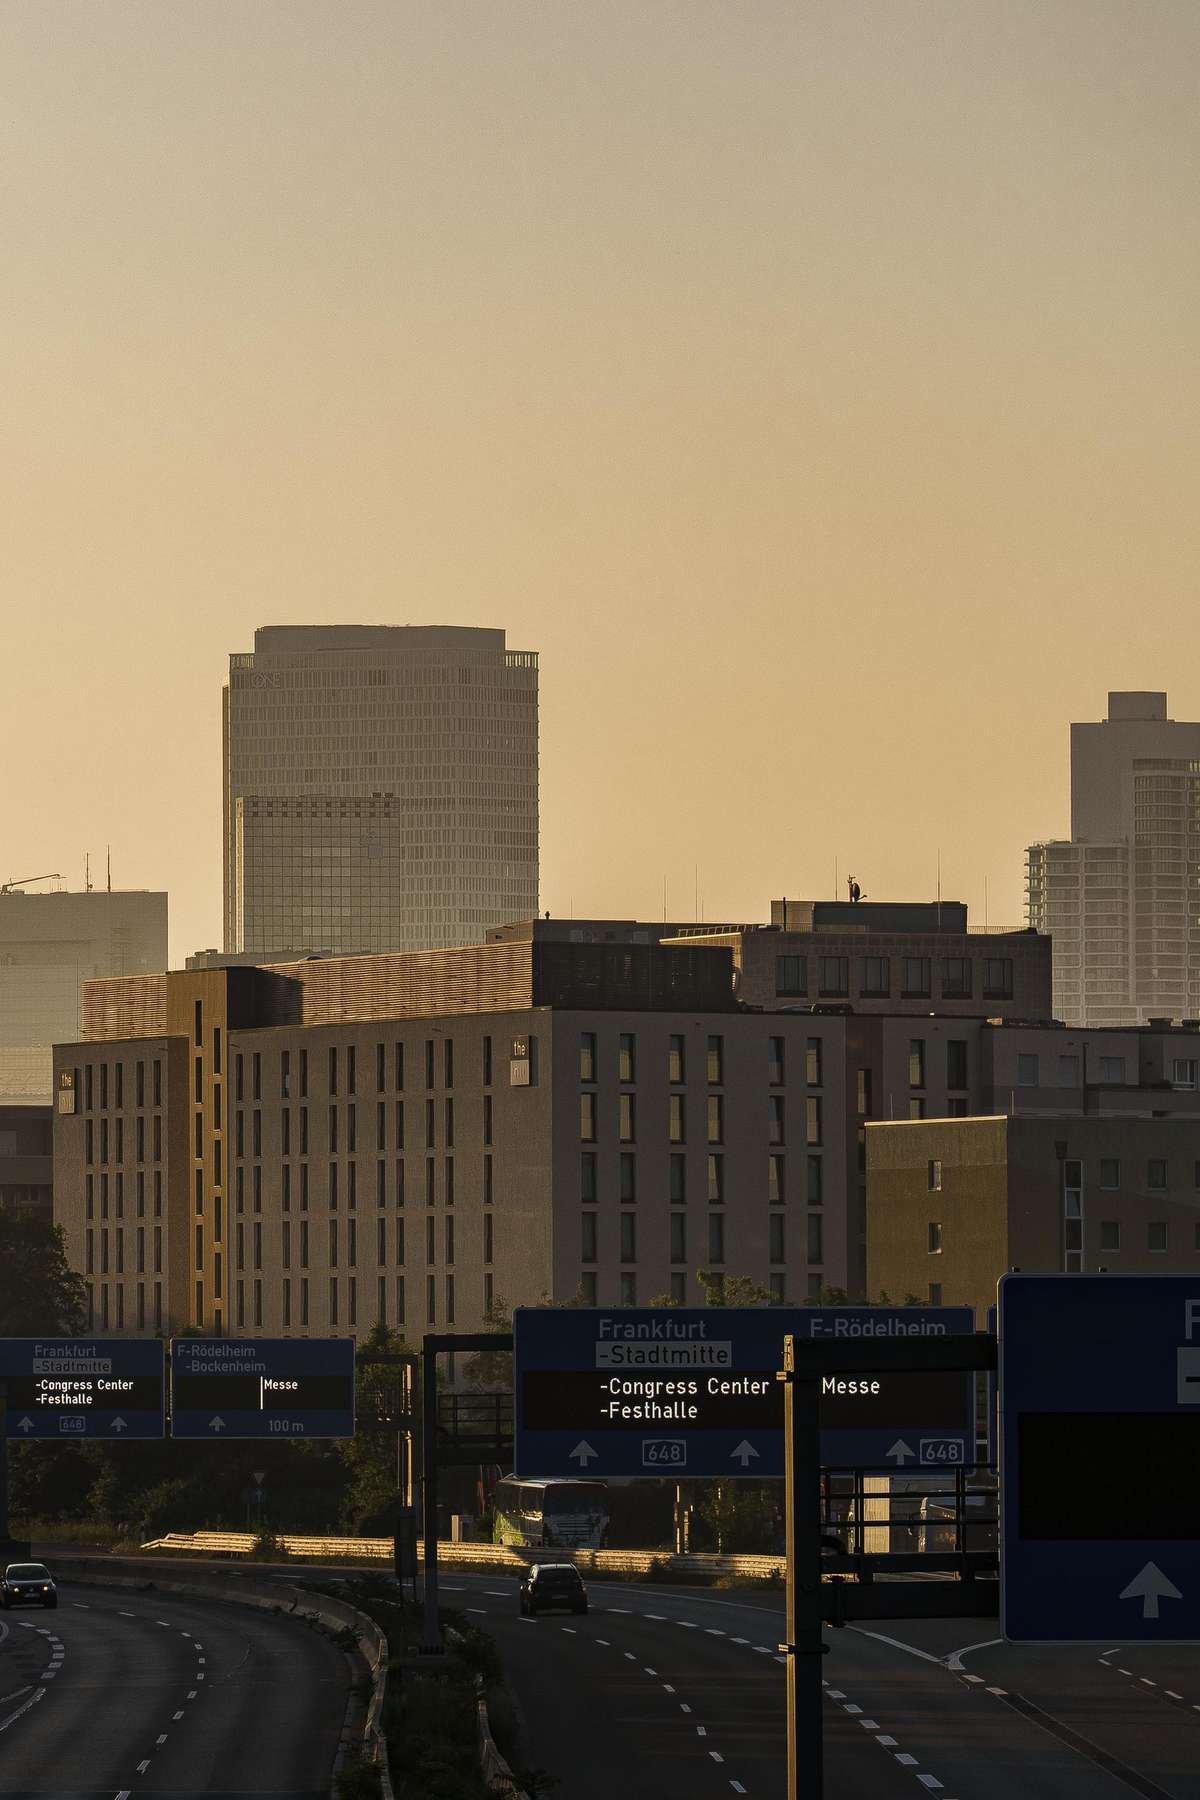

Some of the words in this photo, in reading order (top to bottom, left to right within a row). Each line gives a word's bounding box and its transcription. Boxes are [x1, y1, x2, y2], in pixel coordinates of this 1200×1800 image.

[514, 1041, 526, 1056] the
[599, 1319, 706, 1338] Frankfurt
[810, 1318, 946, 1337] F-Rödelheim
[34, 1345, 97, 1357] Frankfurt
[177, 1344, 256, 1357] F-Rödelheim
[600, 1345, 728, 1364] -Stadtmitte
[185, 1360, 266, 1372] -Bockenheim
[35, 1379, 93, 1392] -Congress
[97, 1379, 134, 1390] Center
[264, 1379, 299, 1390] Messe
[600, 1377, 698, 1399] -Congress
[707, 1377, 770, 1395] Center
[822, 1377, 881, 1395] Messe
[35, 1393, 93, 1405] -Festhalle
[600, 1401, 698, 1419] -Festhalle
[63, 1419, 82, 1429] 648
[268, 1420, 289, 1432] 100
[292, 1423, 304, 1432] m
[648, 1445, 680, 1461] 648
[925, 1444, 959, 1460] 648
